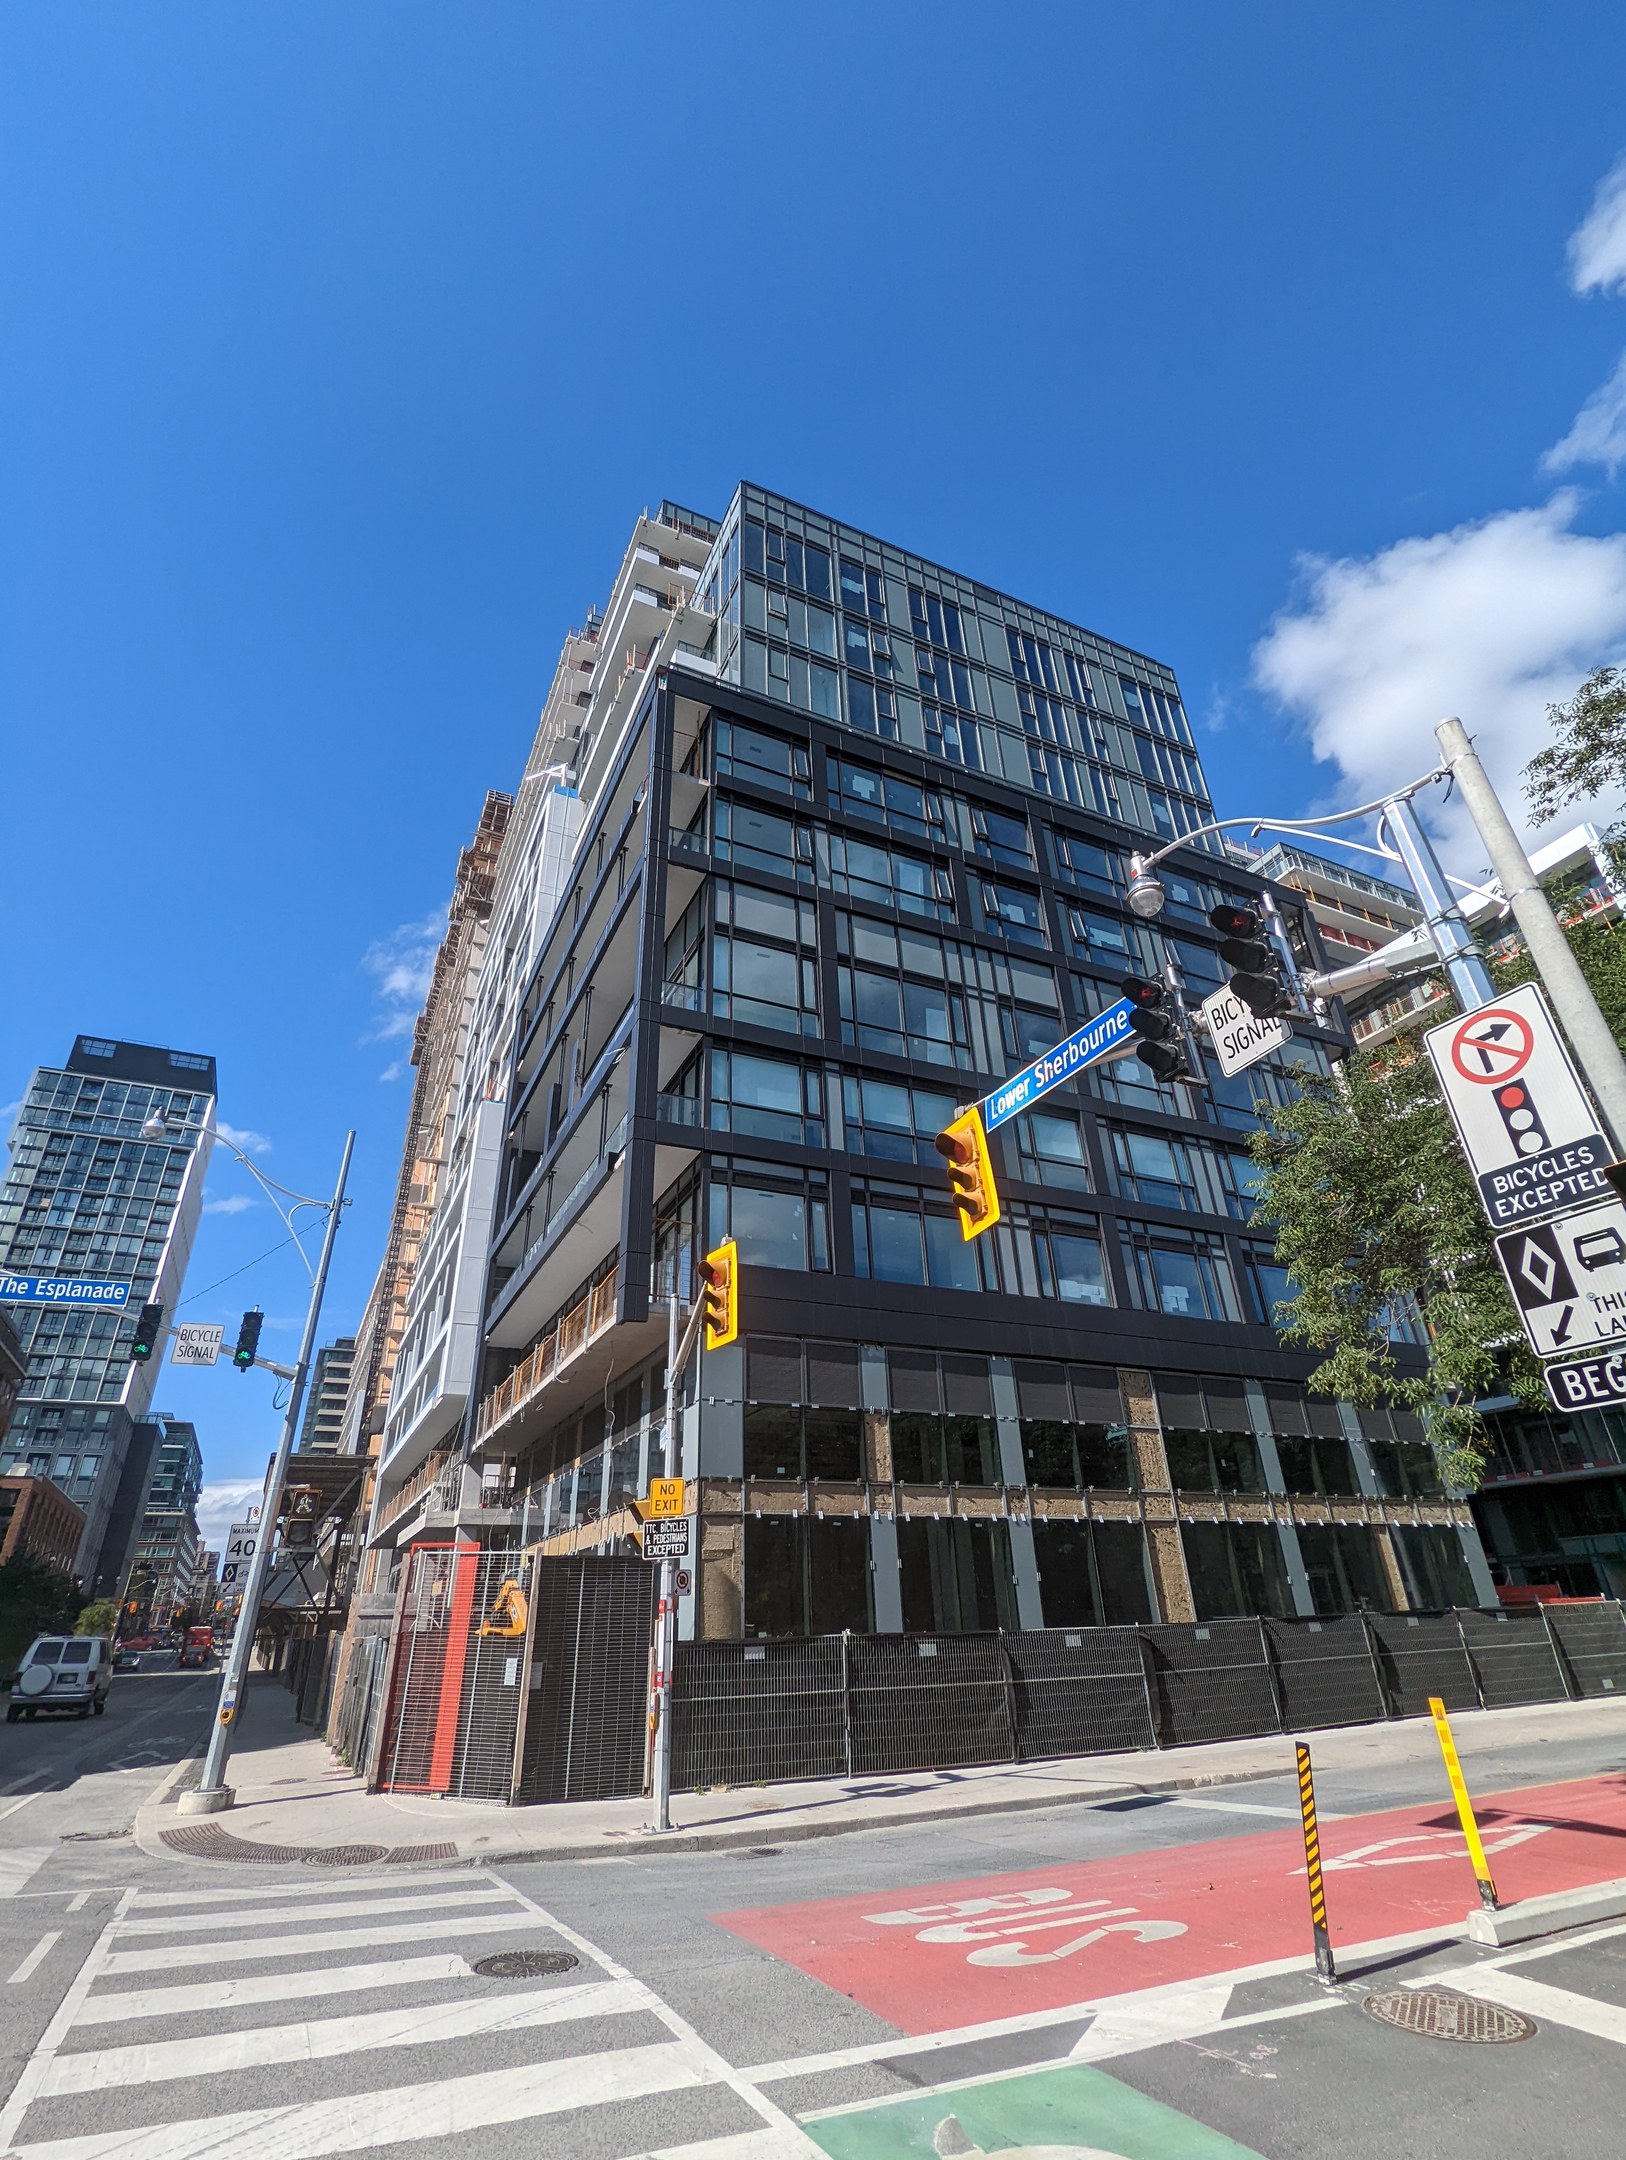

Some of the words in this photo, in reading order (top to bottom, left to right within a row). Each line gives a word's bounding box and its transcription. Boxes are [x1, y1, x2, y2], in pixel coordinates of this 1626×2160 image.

[1211, 995, 1245, 1031] BICY
[1223, 1016, 1282, 1059] SIGNAL
[991, 1077, 1031, 1120] Lower
[1034, 1009, 1128, 1088] Sherbourne
[1492, 1146, 1595, 1194] BICYCLES
[1494, 1167, 1609, 1218] EXCEPTED
[0, 1277, 29, 1295] The
[35, 1278, 125, 1300] Esplanade
[1592, 1290, 1626, 1313] THI
[180, 1328, 222, 1343] BICYCLE
[177, 1345, 214, 1359] SIGNAL
[660, 1484, 675, 1495] NO
[655, 1499, 678, 1511] EXIT
[660, 1521, 687, 1533] BICYCLES
[229, 1539, 256, 1557] 40
[646, 1534, 651, 1545] &
[653, 1532, 687, 1544] PEDESTRIANS
[647, 1543, 685, 1556] EXCEPTED
[861, 1887, 1189, 1967] BUS
